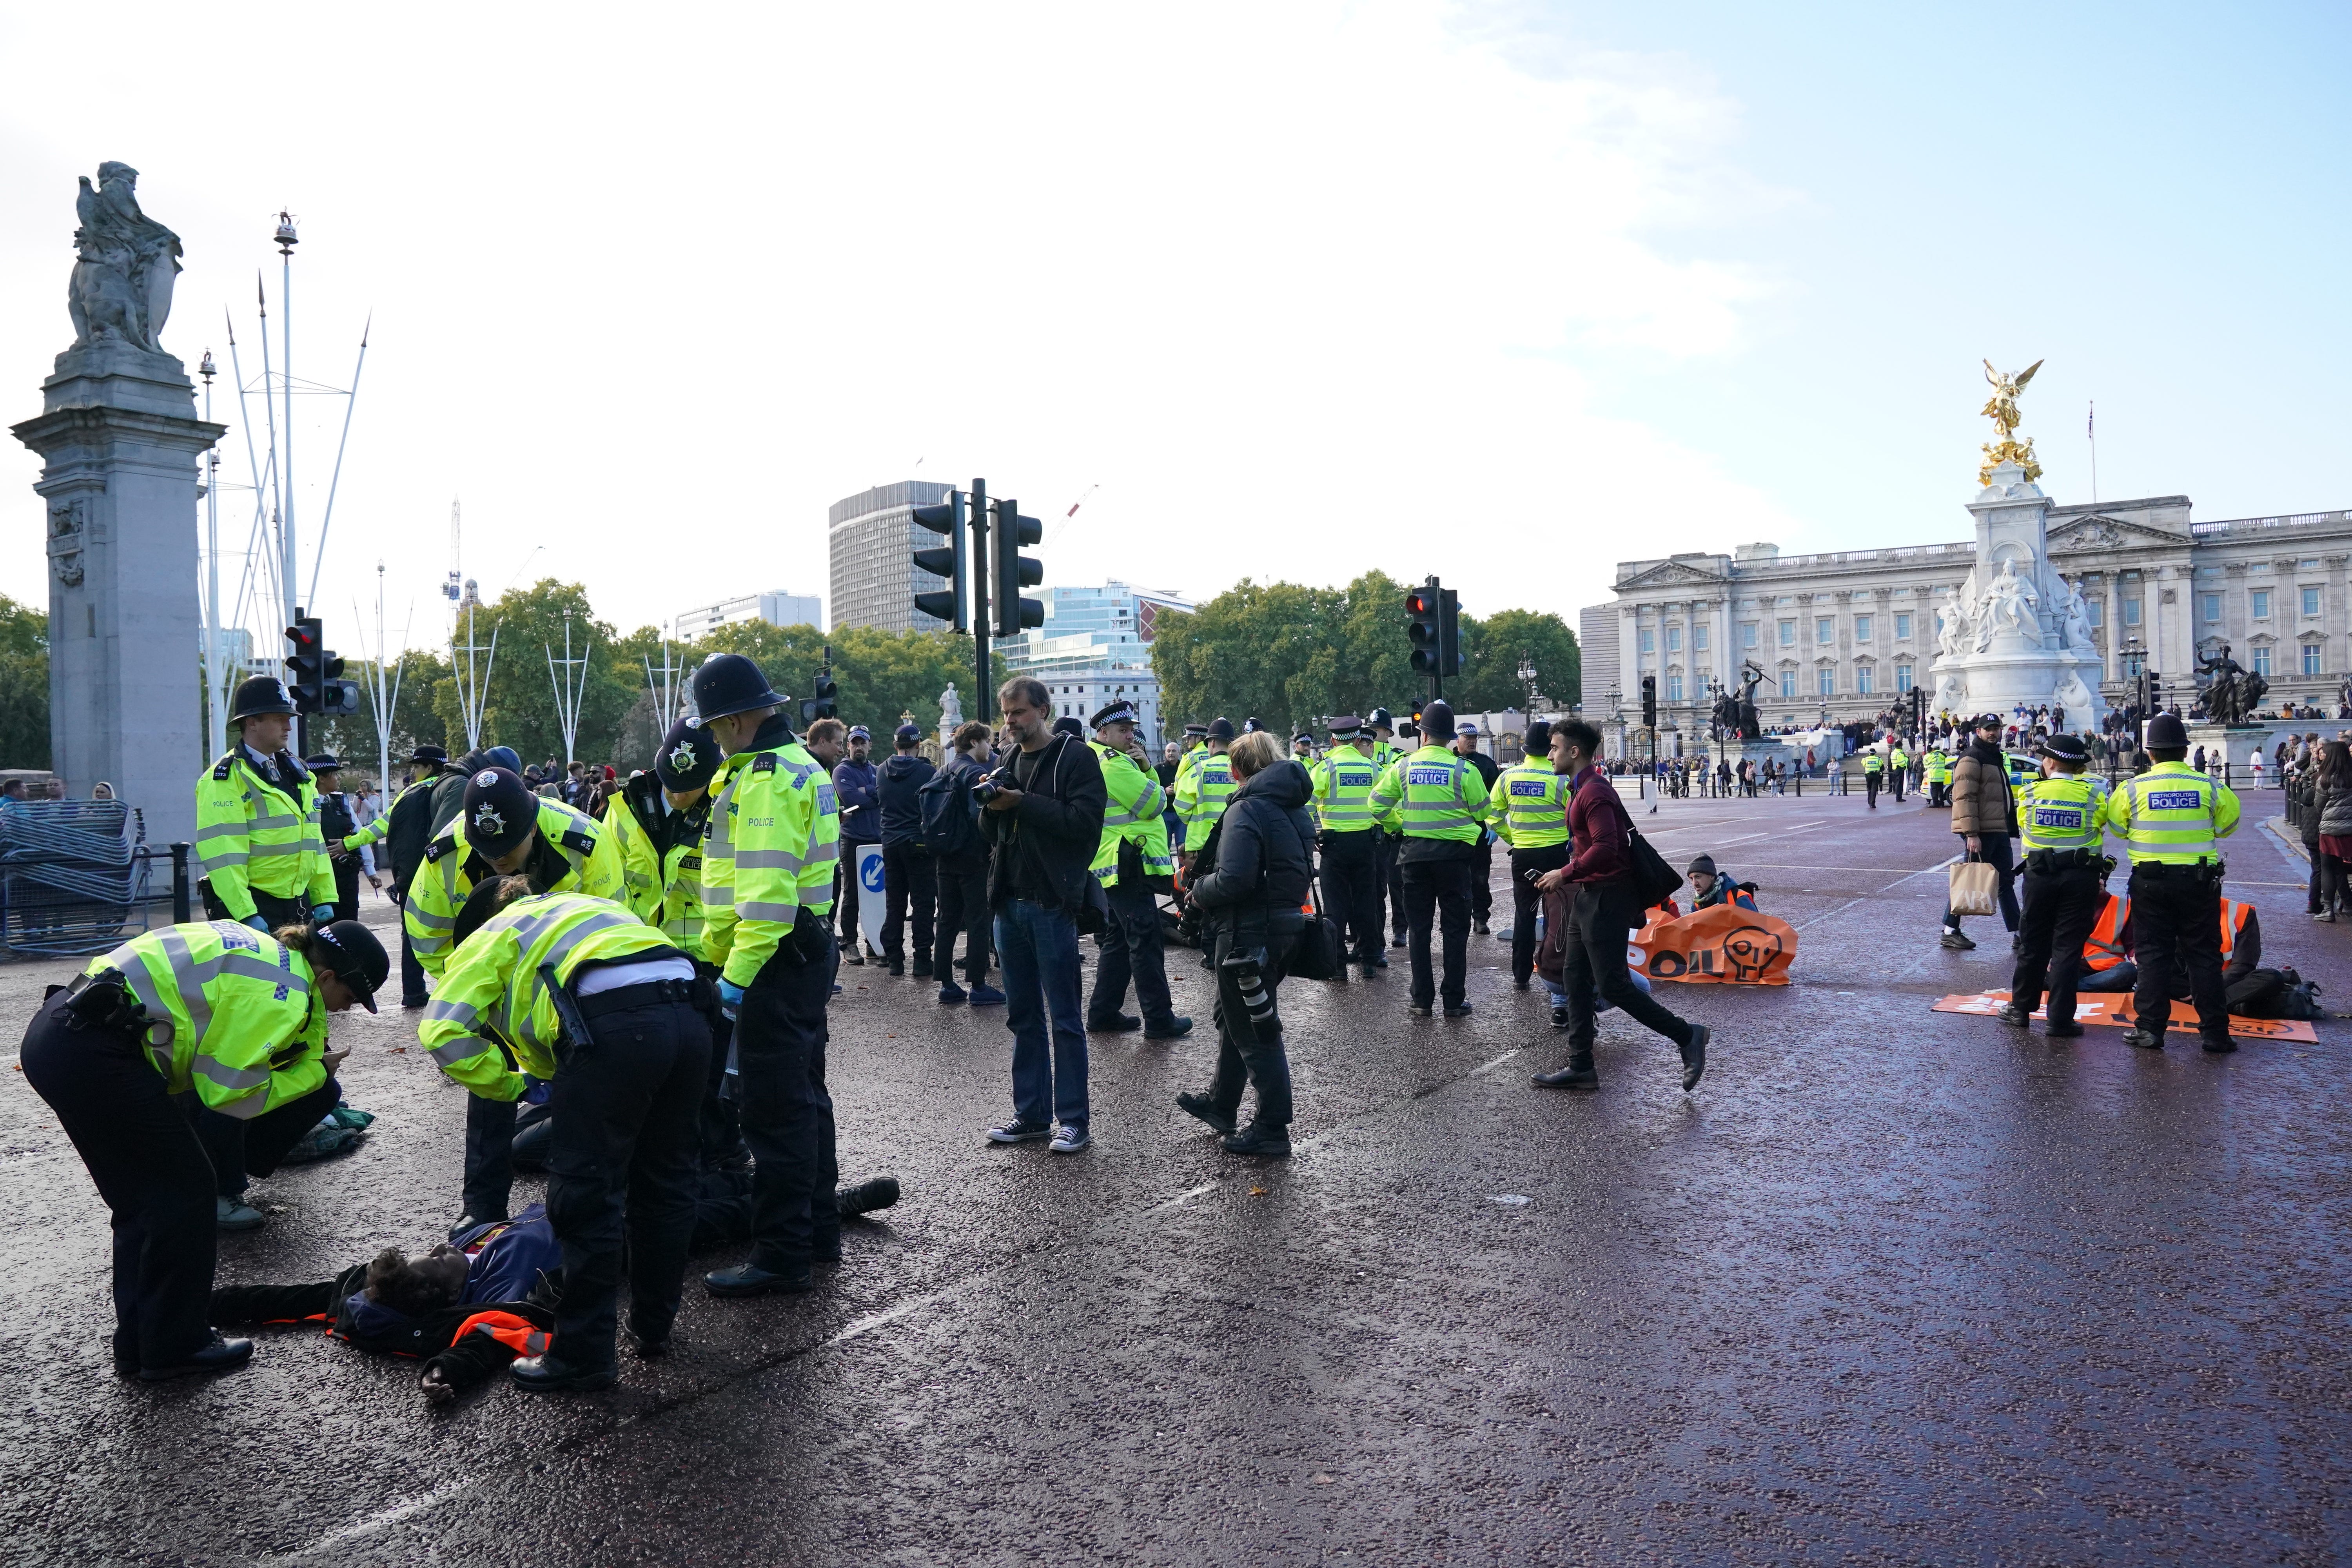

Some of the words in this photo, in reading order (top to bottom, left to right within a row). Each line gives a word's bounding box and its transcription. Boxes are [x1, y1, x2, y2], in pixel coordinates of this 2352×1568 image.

[1410, 774, 1447, 784] POLICE
[1512, 786, 1544, 795] POLICE
[2152, 798, 2196, 808] POLICE
[749, 818, 774, 826] POLICE
[2036, 813, 2080, 826] POLICE
[1649, 949, 1726, 978] OIL
